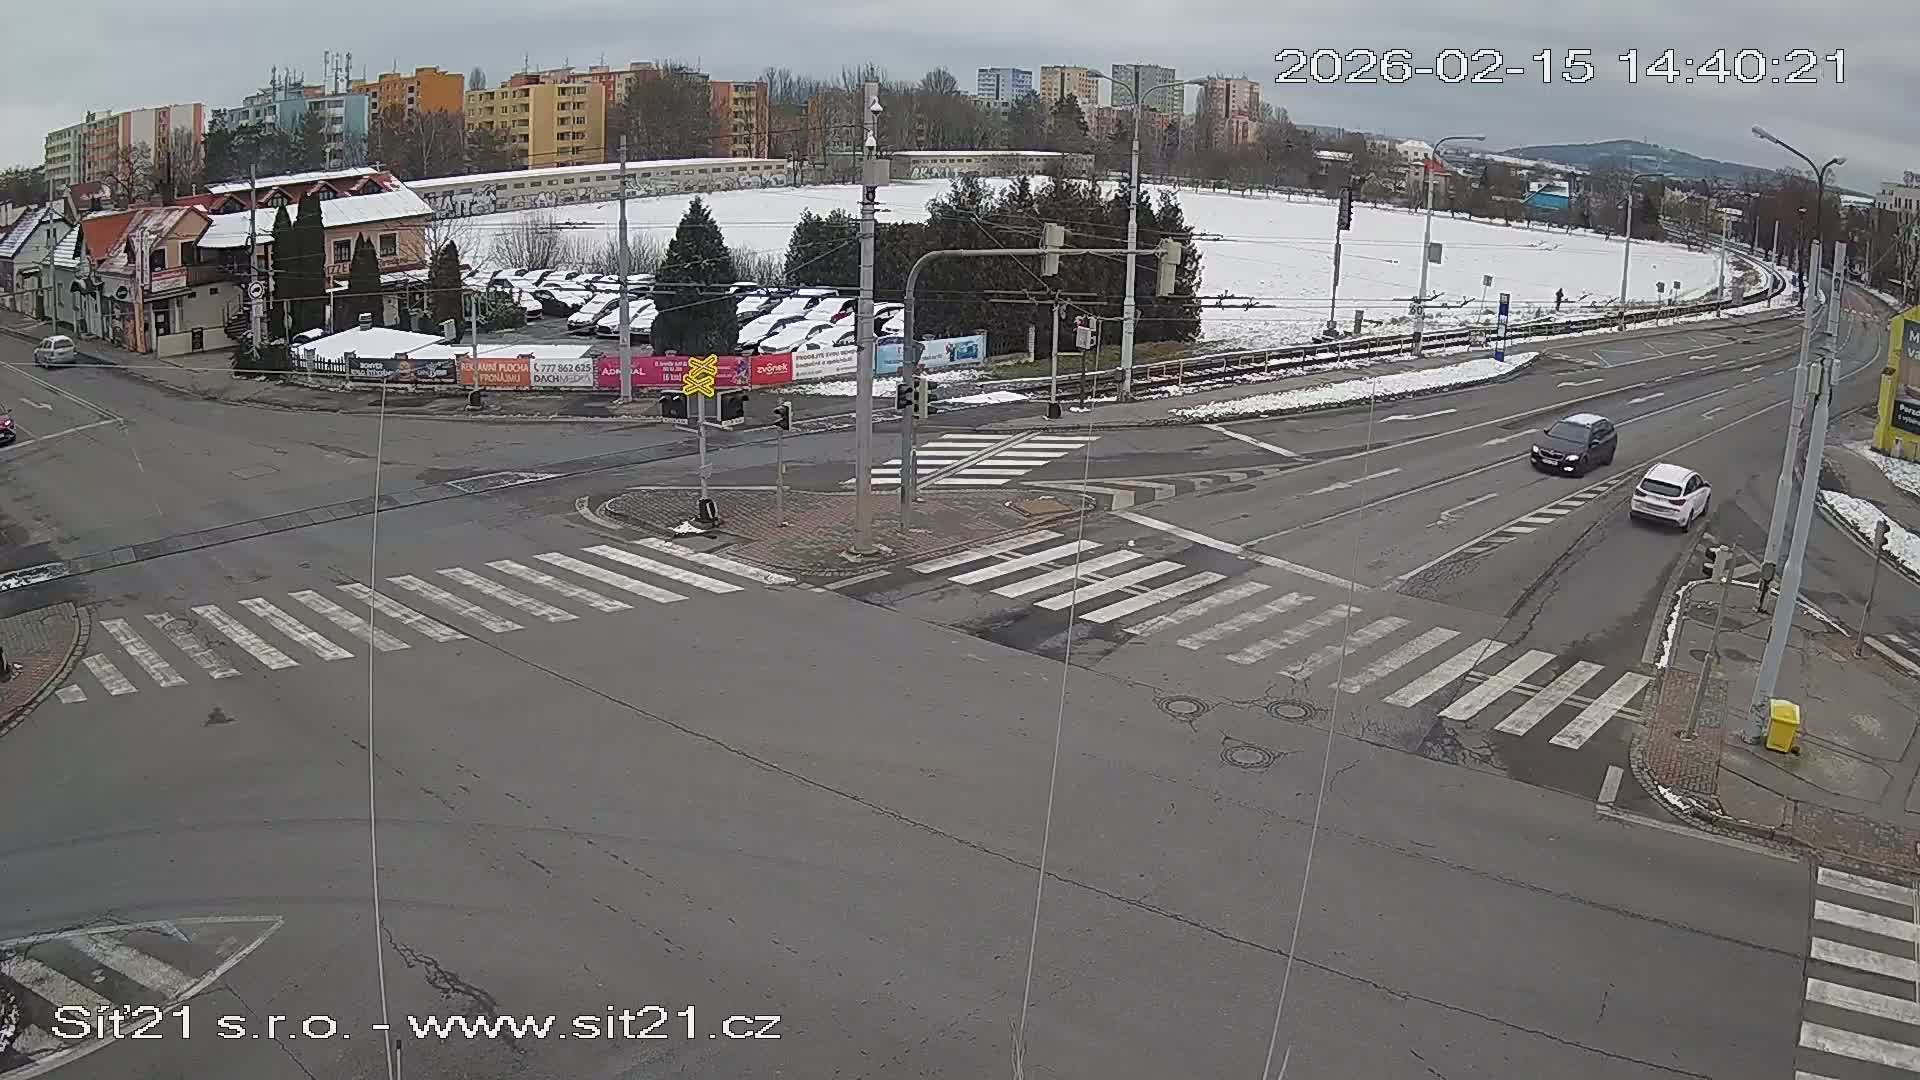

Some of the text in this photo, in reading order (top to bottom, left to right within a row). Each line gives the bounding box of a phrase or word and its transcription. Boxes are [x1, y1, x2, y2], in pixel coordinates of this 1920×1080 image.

[460, 362, 529, 372] REKAMNÍ PLOCHA
[540, 363, 592, 373] 777 862 625
[533, 374, 592, 384] DACHMEDIA
